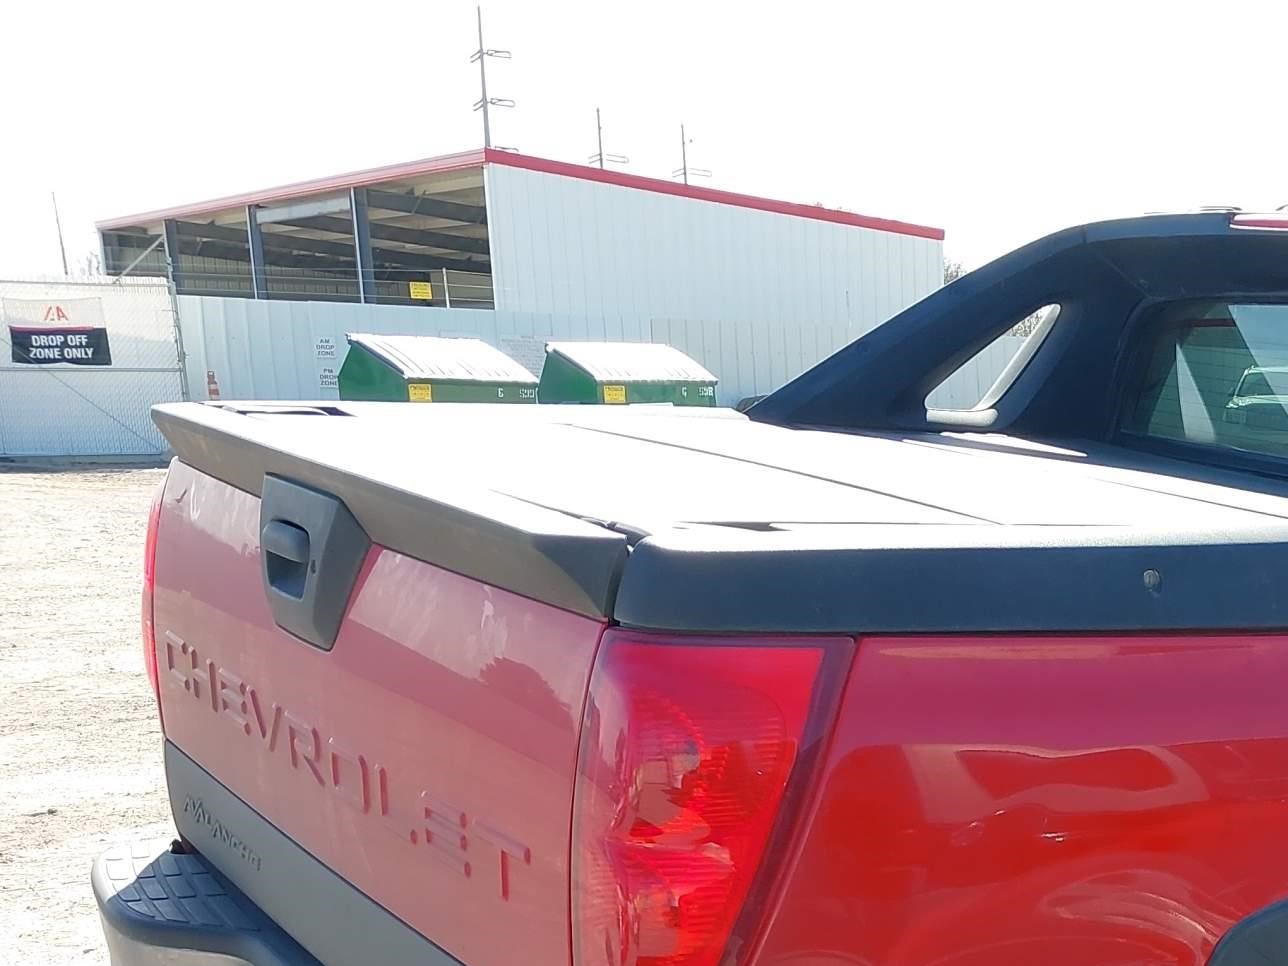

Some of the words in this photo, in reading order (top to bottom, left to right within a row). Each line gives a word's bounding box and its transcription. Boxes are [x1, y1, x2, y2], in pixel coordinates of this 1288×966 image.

[31, 335, 64, 346] DROP
[67, 335, 88, 346] OFF
[29, 348, 61, 359] ZONE
[64, 348, 93, 359] ONLY
[164, 630, 532, 902] CHEVROLET
